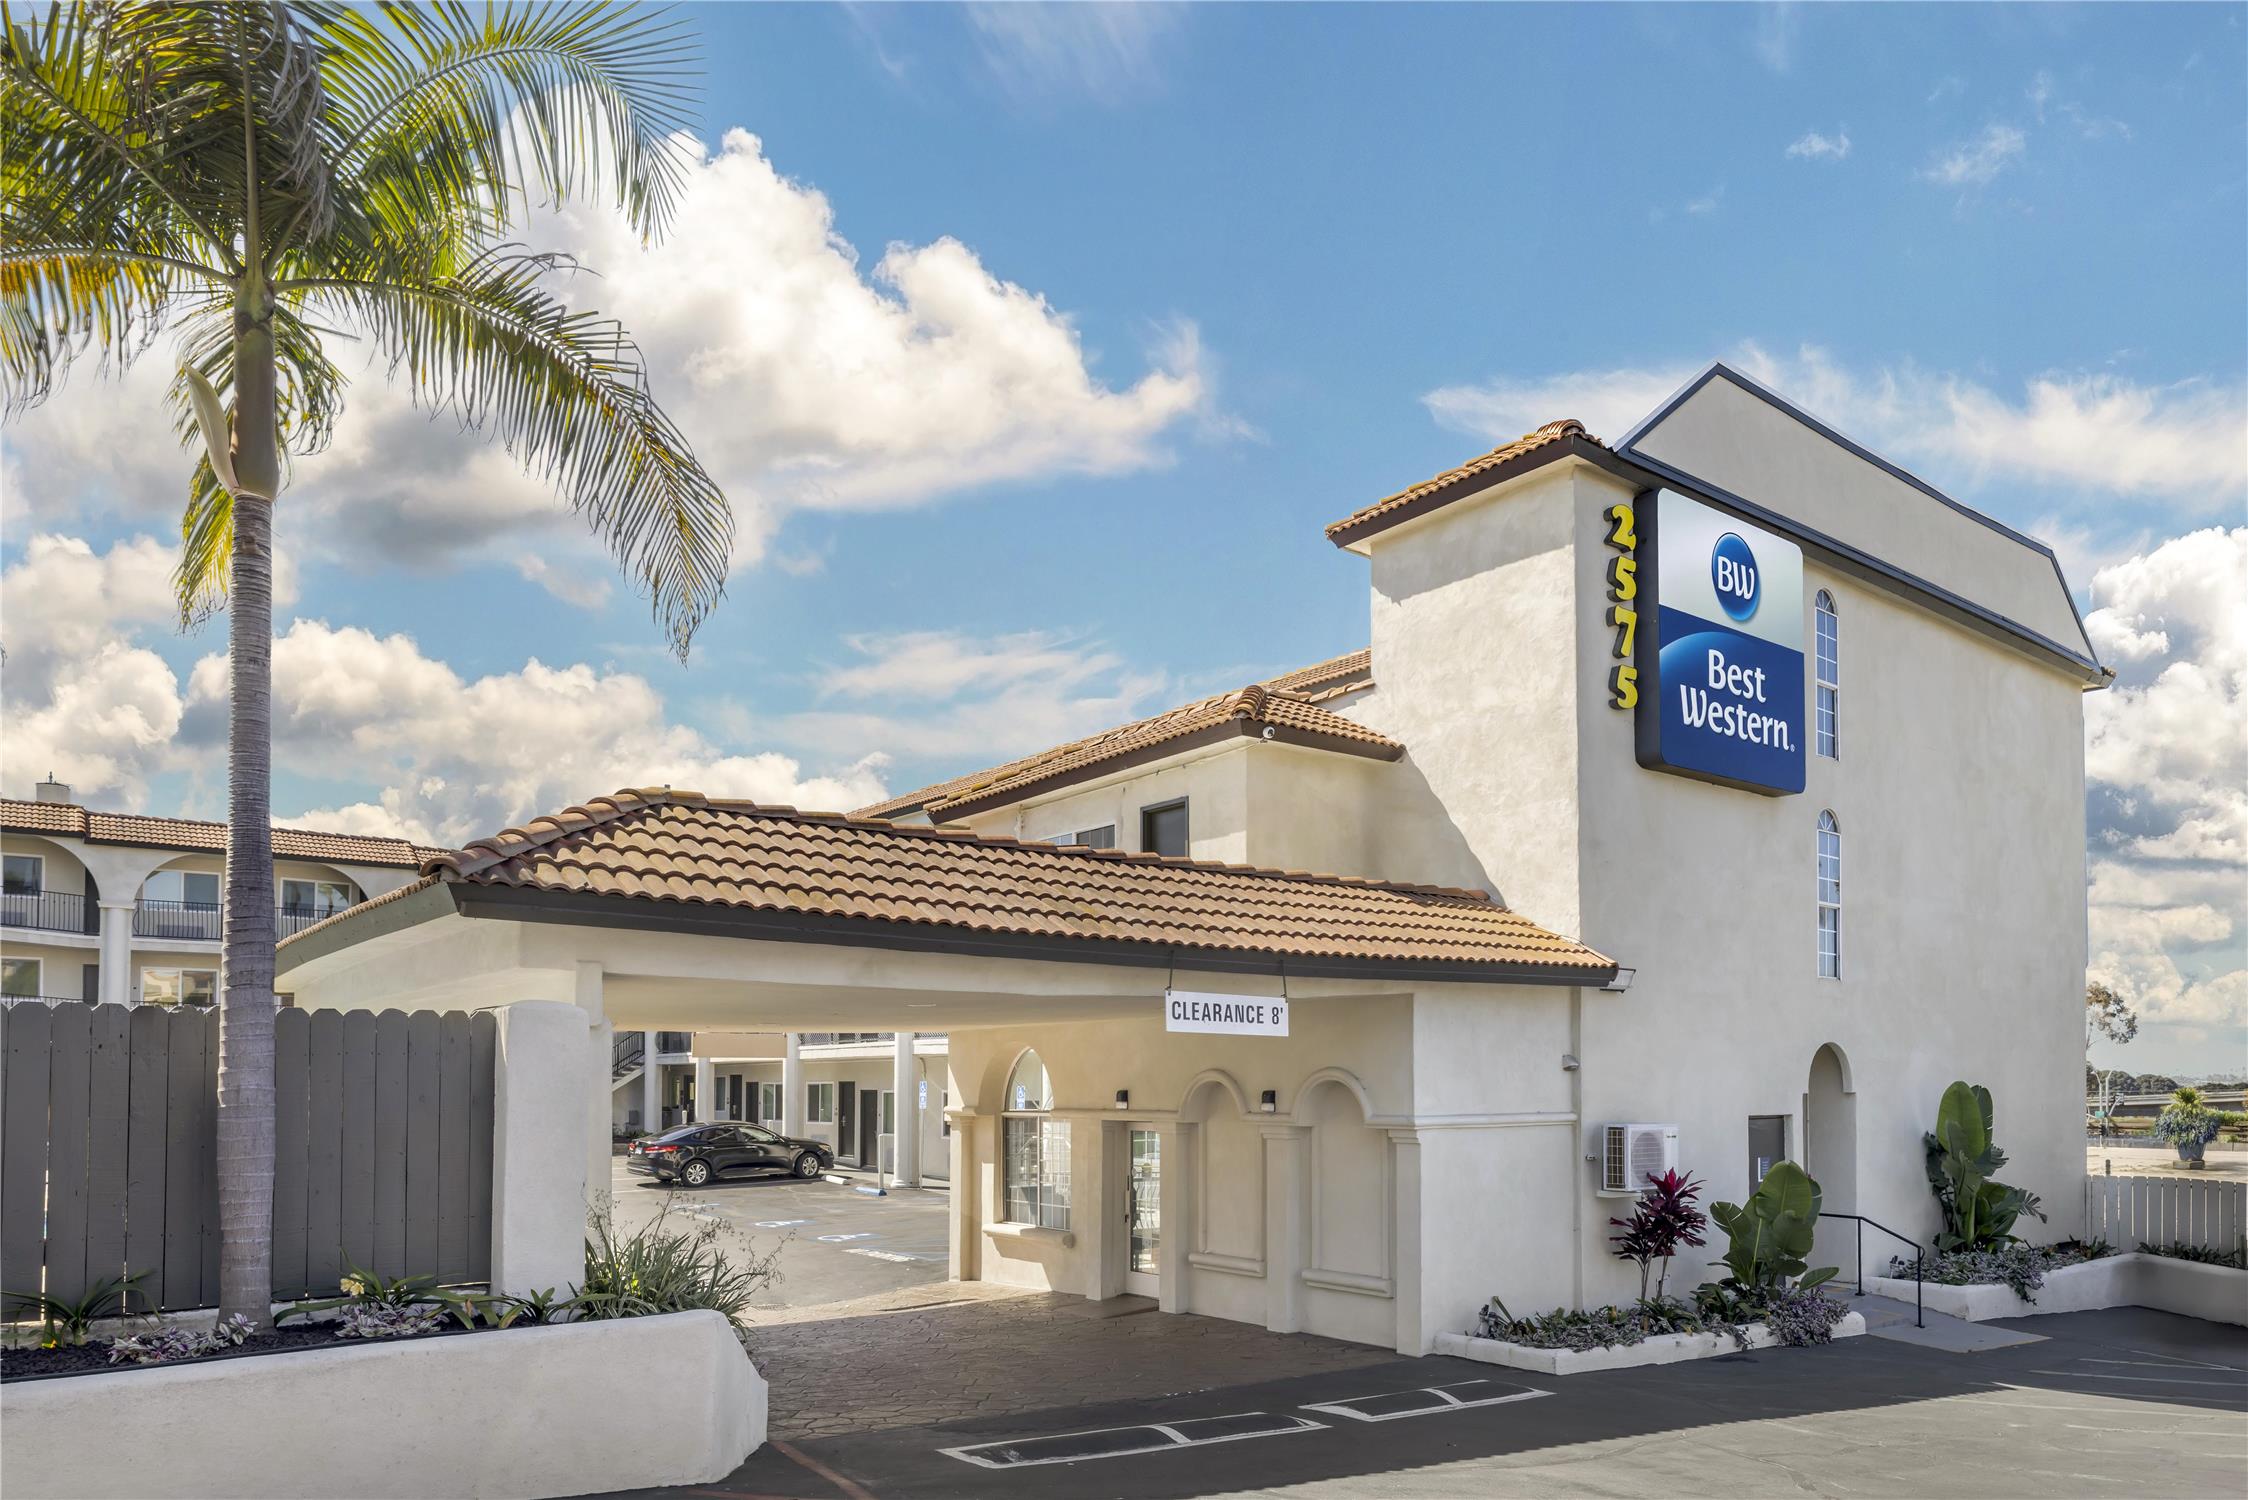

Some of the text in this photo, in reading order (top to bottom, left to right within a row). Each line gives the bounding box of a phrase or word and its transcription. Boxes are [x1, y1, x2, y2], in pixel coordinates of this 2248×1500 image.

[1717, 555, 1756, 600] BW
[1603, 504, 1638, 710] 2575
[1708, 648, 1767, 703] Best
[1171, 1000, 1284, 1025] CLEARANCE 8'
